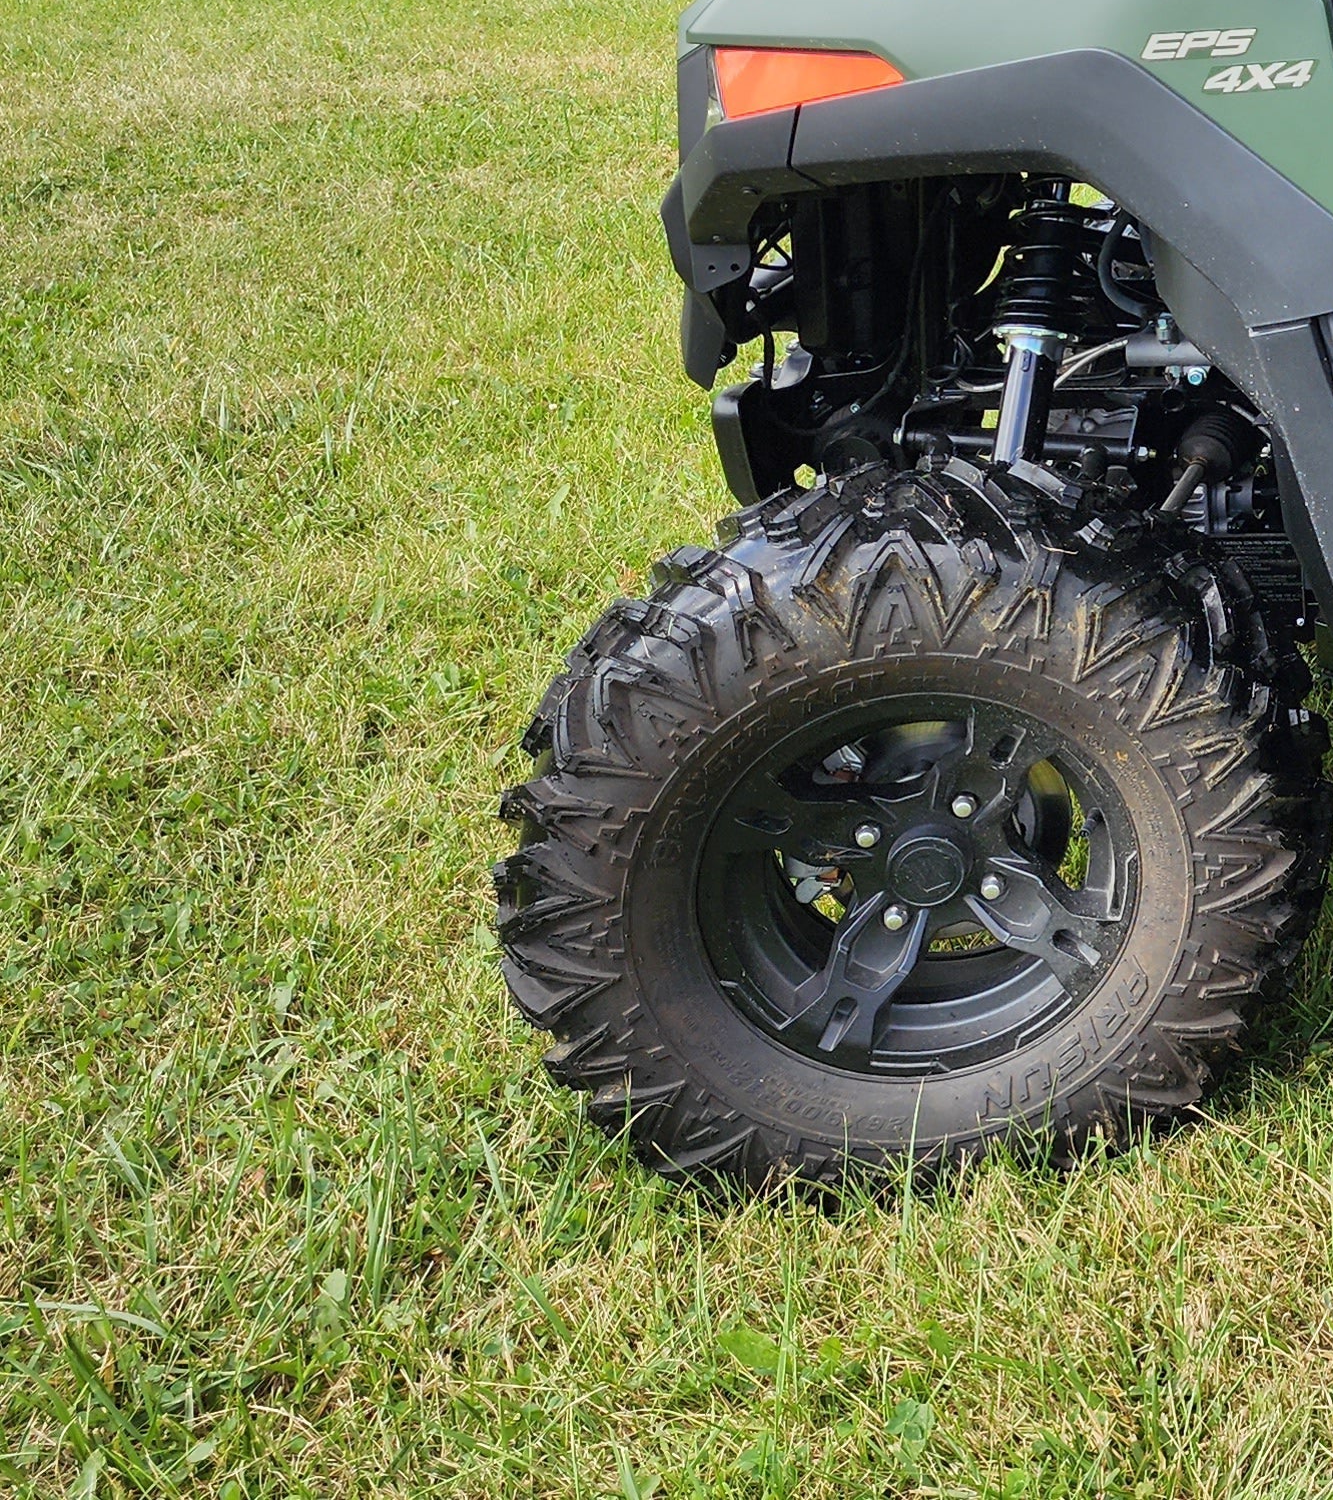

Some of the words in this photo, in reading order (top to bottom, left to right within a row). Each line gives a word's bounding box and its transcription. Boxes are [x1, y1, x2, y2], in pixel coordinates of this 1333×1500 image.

[1141, 28, 1257, 60] EPS
[1203, 59, 1315, 93] 4X4
[975, 954, 1149, 1119] ARISUN
